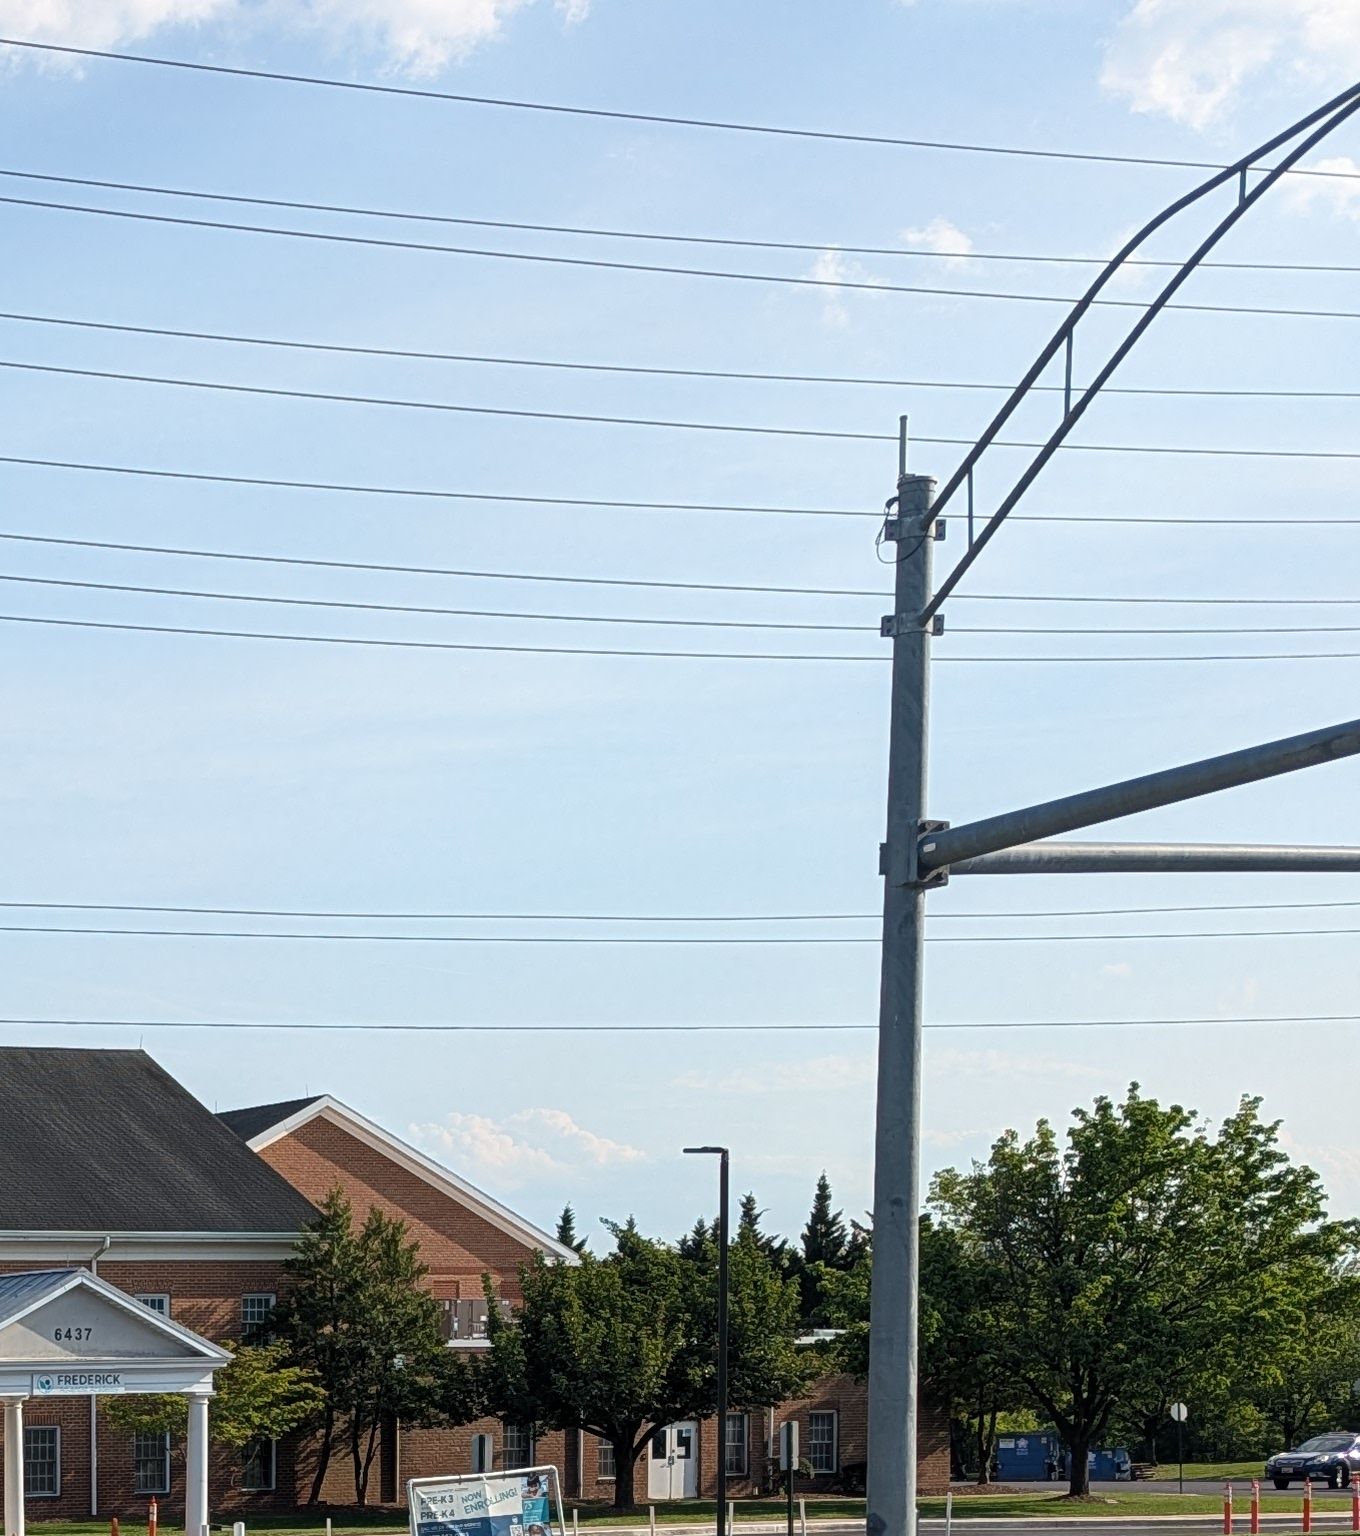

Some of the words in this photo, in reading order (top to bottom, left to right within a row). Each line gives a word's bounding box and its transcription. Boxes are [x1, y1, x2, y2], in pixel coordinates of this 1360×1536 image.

[54, 1328, 92, 1341] 6437
[57, 1374, 120, 1385] FREDERICK
[448, 1494, 454, 1503] 3
[461, 1490, 482, 1504] NOW
[464, 1488, 517, 1514] ENROLLING!
[420, 1510, 448, 1520] PRE-K
[449, 1509, 455, 1517] 4
